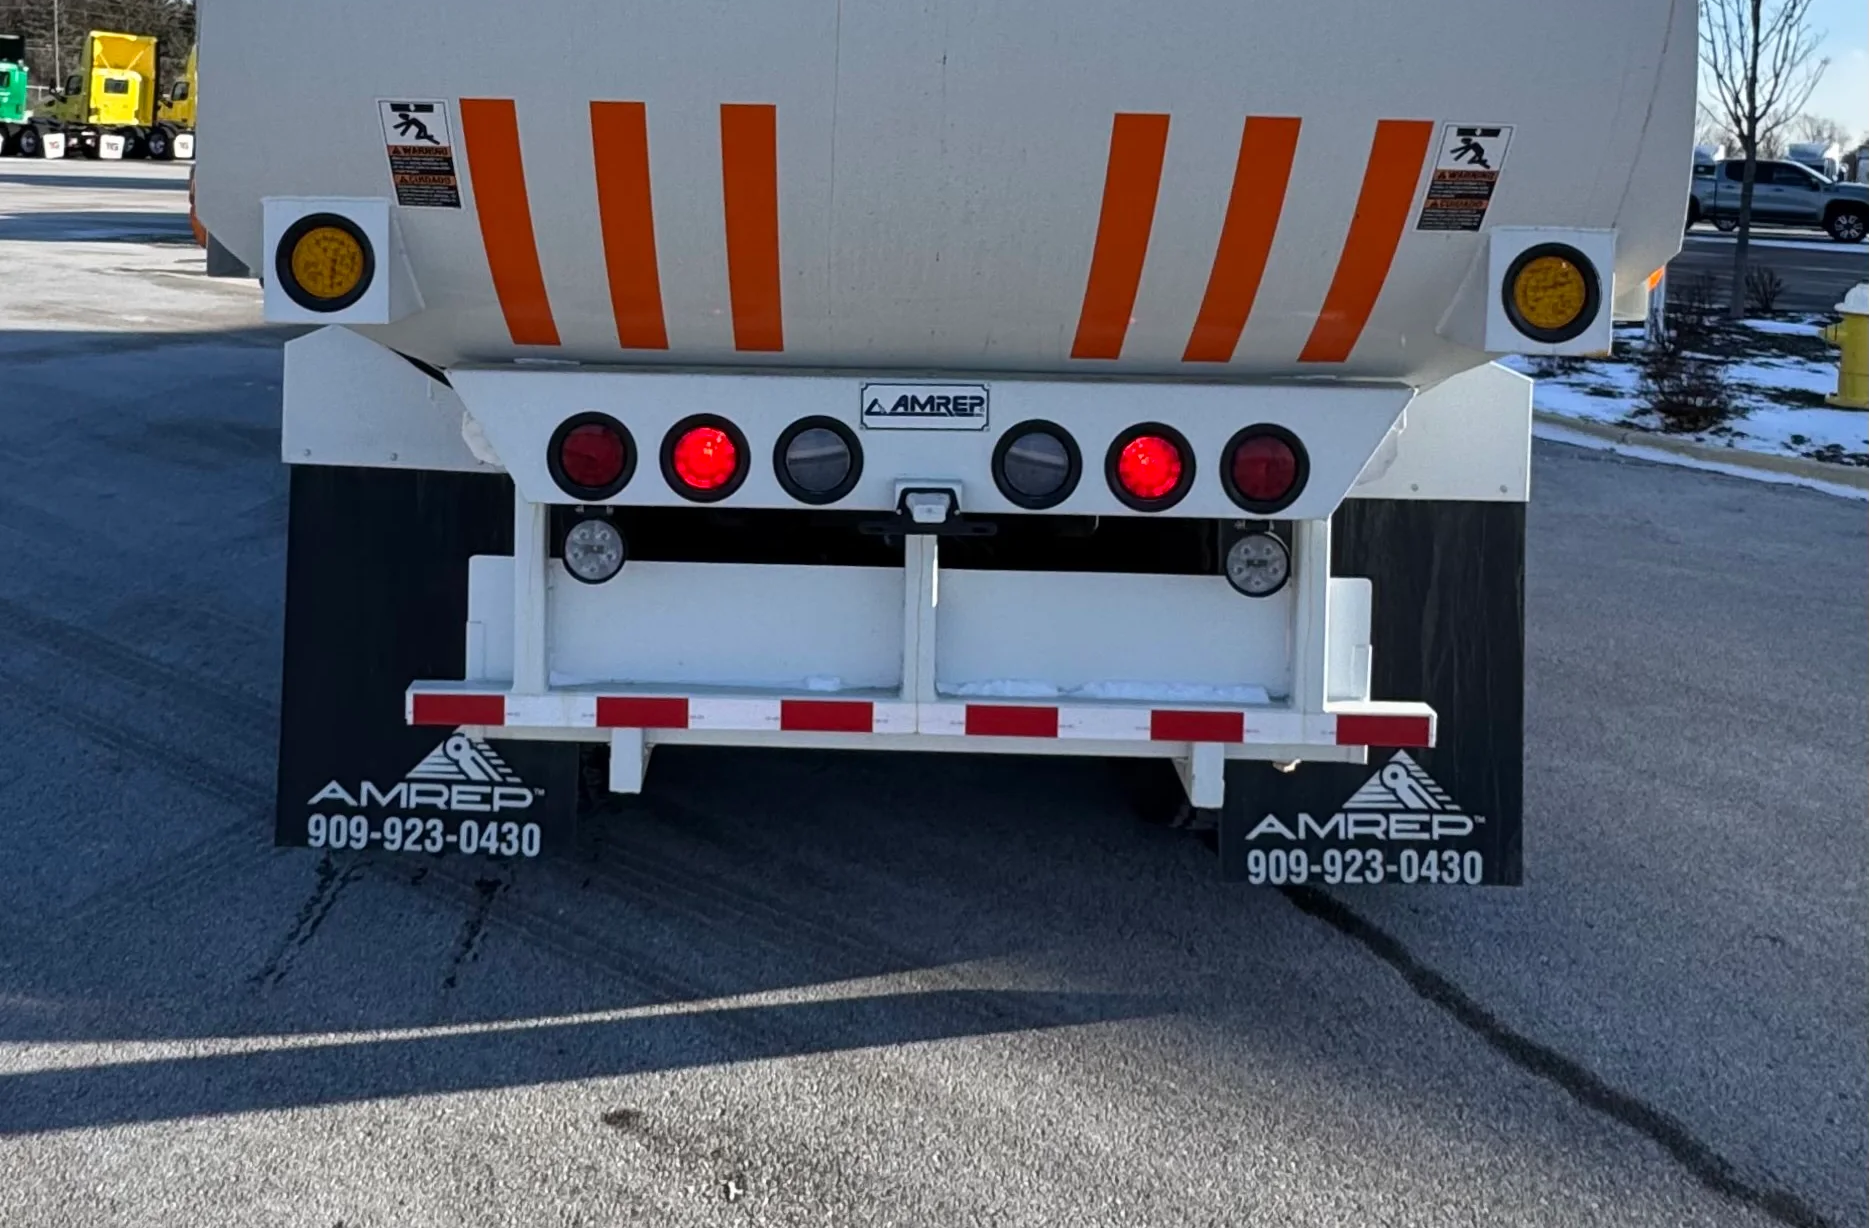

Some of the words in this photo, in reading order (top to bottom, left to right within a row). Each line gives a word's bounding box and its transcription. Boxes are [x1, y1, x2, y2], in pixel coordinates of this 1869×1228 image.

[889, 394, 985, 417] AMREP
[307, 779, 534, 812] AMREP
[307, 813, 542, 857] 909-923-0430
[1244, 813, 1474, 841] AMREP
[1247, 848, 1483, 885] 909-923-0430
